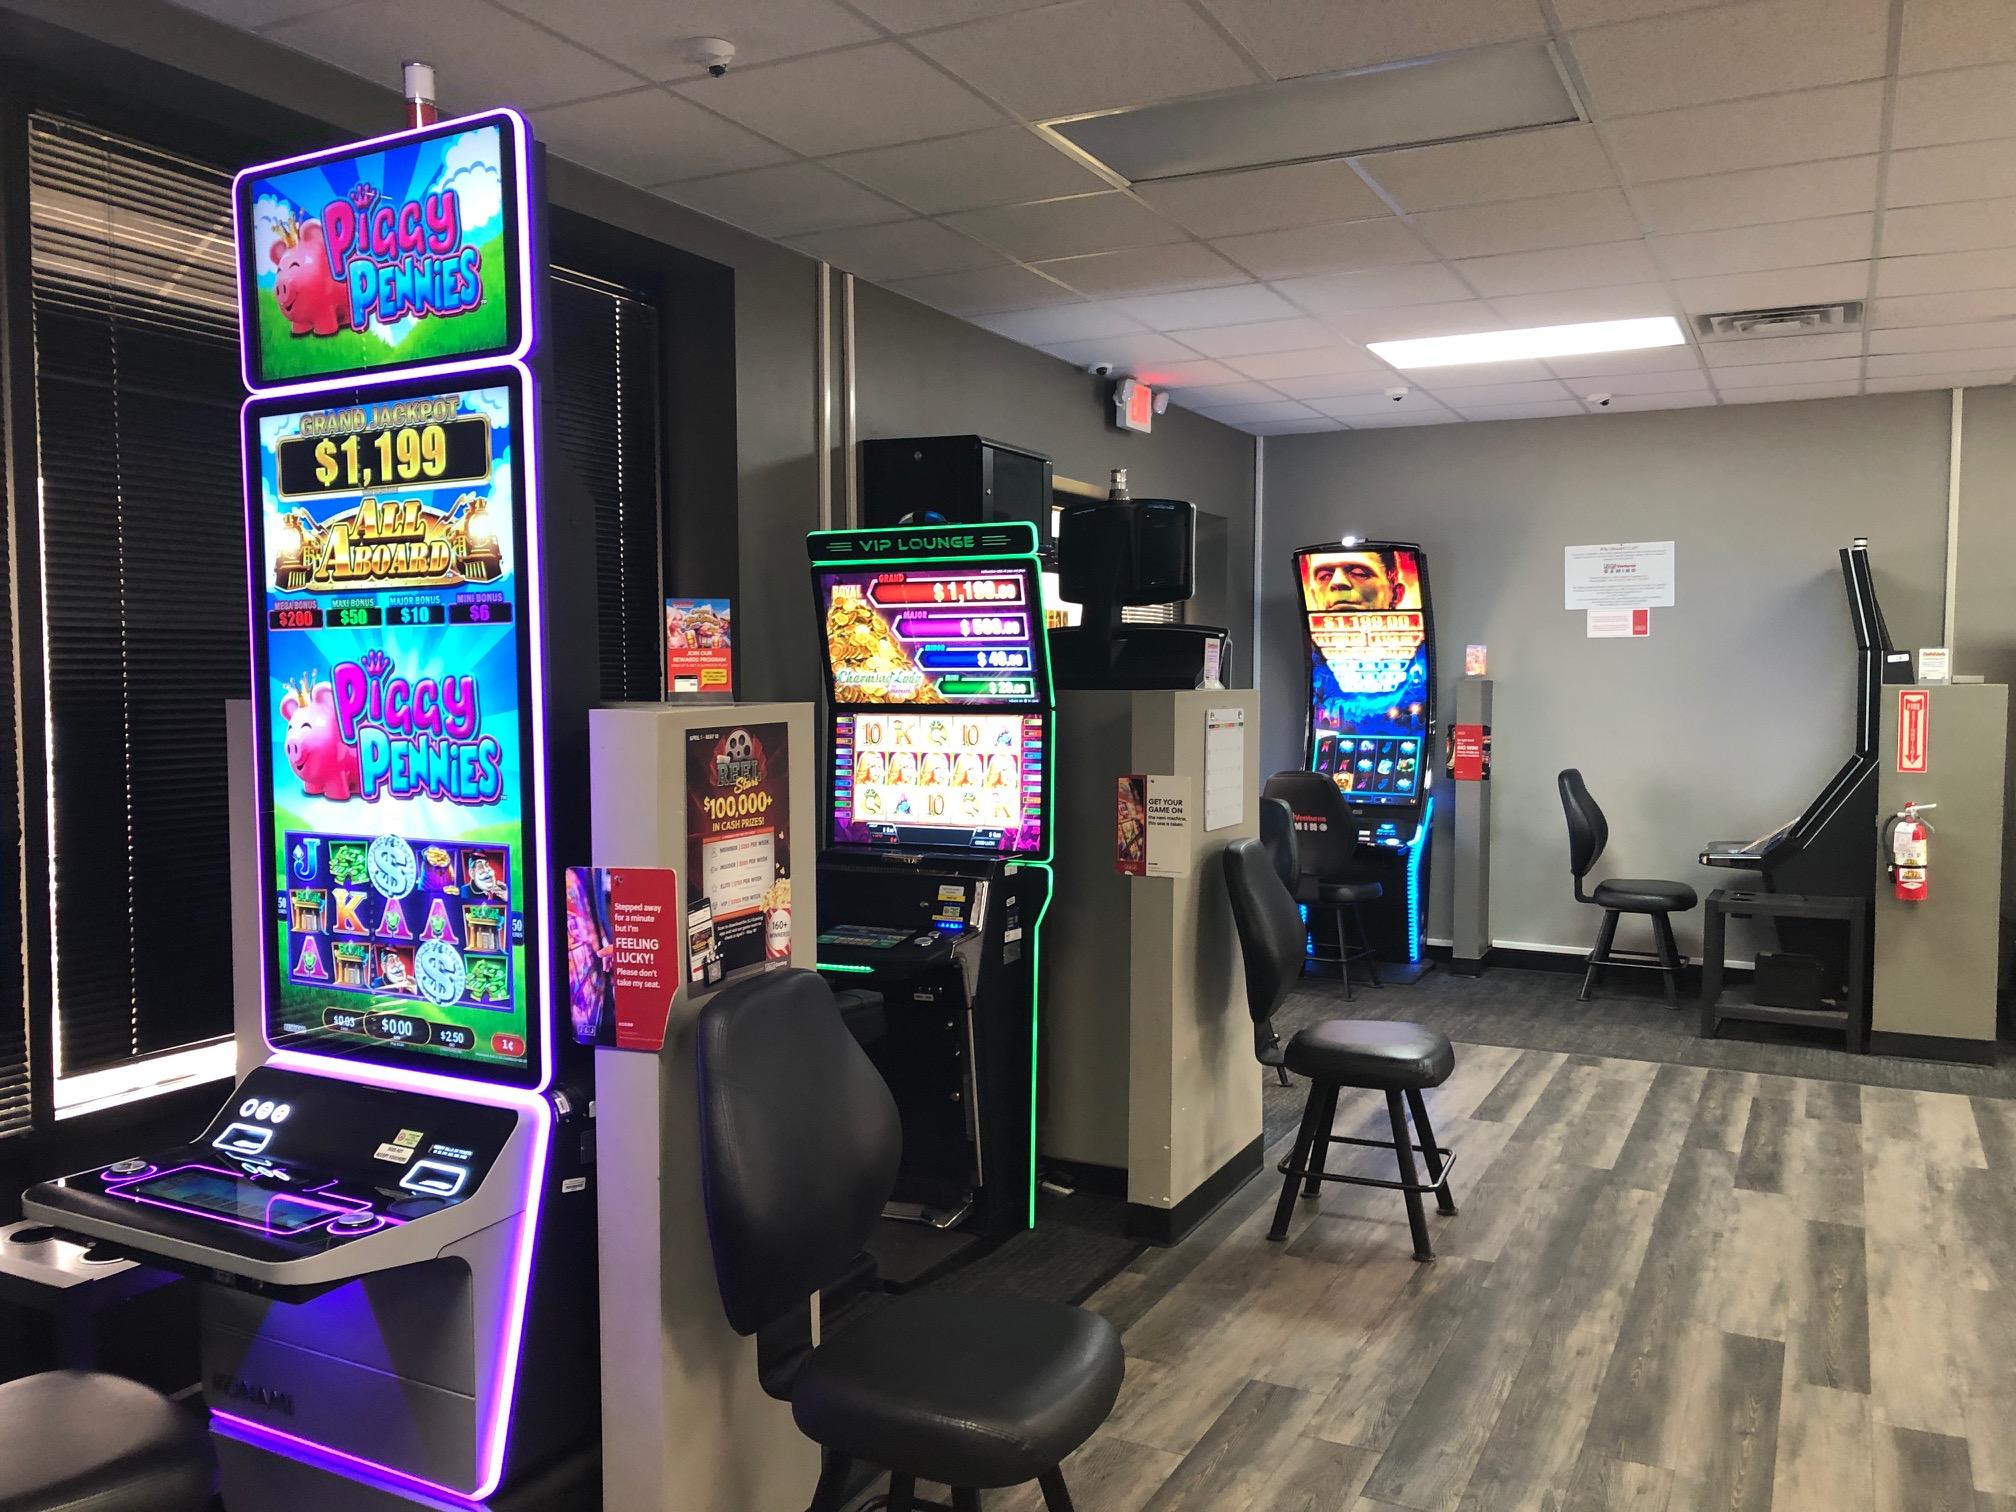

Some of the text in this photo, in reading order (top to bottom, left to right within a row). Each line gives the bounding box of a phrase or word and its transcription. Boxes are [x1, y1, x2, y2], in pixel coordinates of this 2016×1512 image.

[348, 246, 481, 329] PENNIES
[301, 397, 460, 437] GRAND JACKPOT
[315, 425, 446, 487] $1,199
[350, 498, 426, 541] ALL
[315, 524, 450, 580] ABOARD
[859, 536, 975, 552] VIP LOUNGE
[879, 574, 905, 582] GRAND
[274, 600, 316, 610] MEGA BONUS
[332, 599, 374, 608] MAXI BONUS
[390, 595, 440, 605] MAJOR BONUS
[456, 593, 502, 604] MINI BONUS
[279, 611, 313, 627] $200
[340, 609, 368, 625] $50
[401, 607, 430, 623] $10
[470, 606, 490, 622] $6
[903, 611, 927, 619] MAJOR
[864, 722, 882, 745] 10
[962, 724, 979, 746] 10
[358, 725, 501, 801] PENNIES
[717, 760, 759, 786] REEL
[704, 791, 773, 819] $100,000+
[928, 794, 945, 815] 10
[713, 817, 765, 832] IN CASH PRIZES!
[294, 838, 320, 881] J
[332, 888, 369, 936] K
[614, 902, 661, 914] Stepped away
[511, 919, 522, 932] 50
[614, 913, 623, 921] for
[631, 914, 655, 922] minute
[615, 924, 639, 933] but I'm
[615, 937, 659, 950] FEELING
[616, 951, 654, 964] LUCKY!
[616, 967, 657, 978] Please don't
[617, 978, 660, 989] take my seat.
[381, 1017, 413, 1036] $0.00
[440, 1030, 464, 1044] $2.50
[501, 1039, 514, 1051] 1¢
